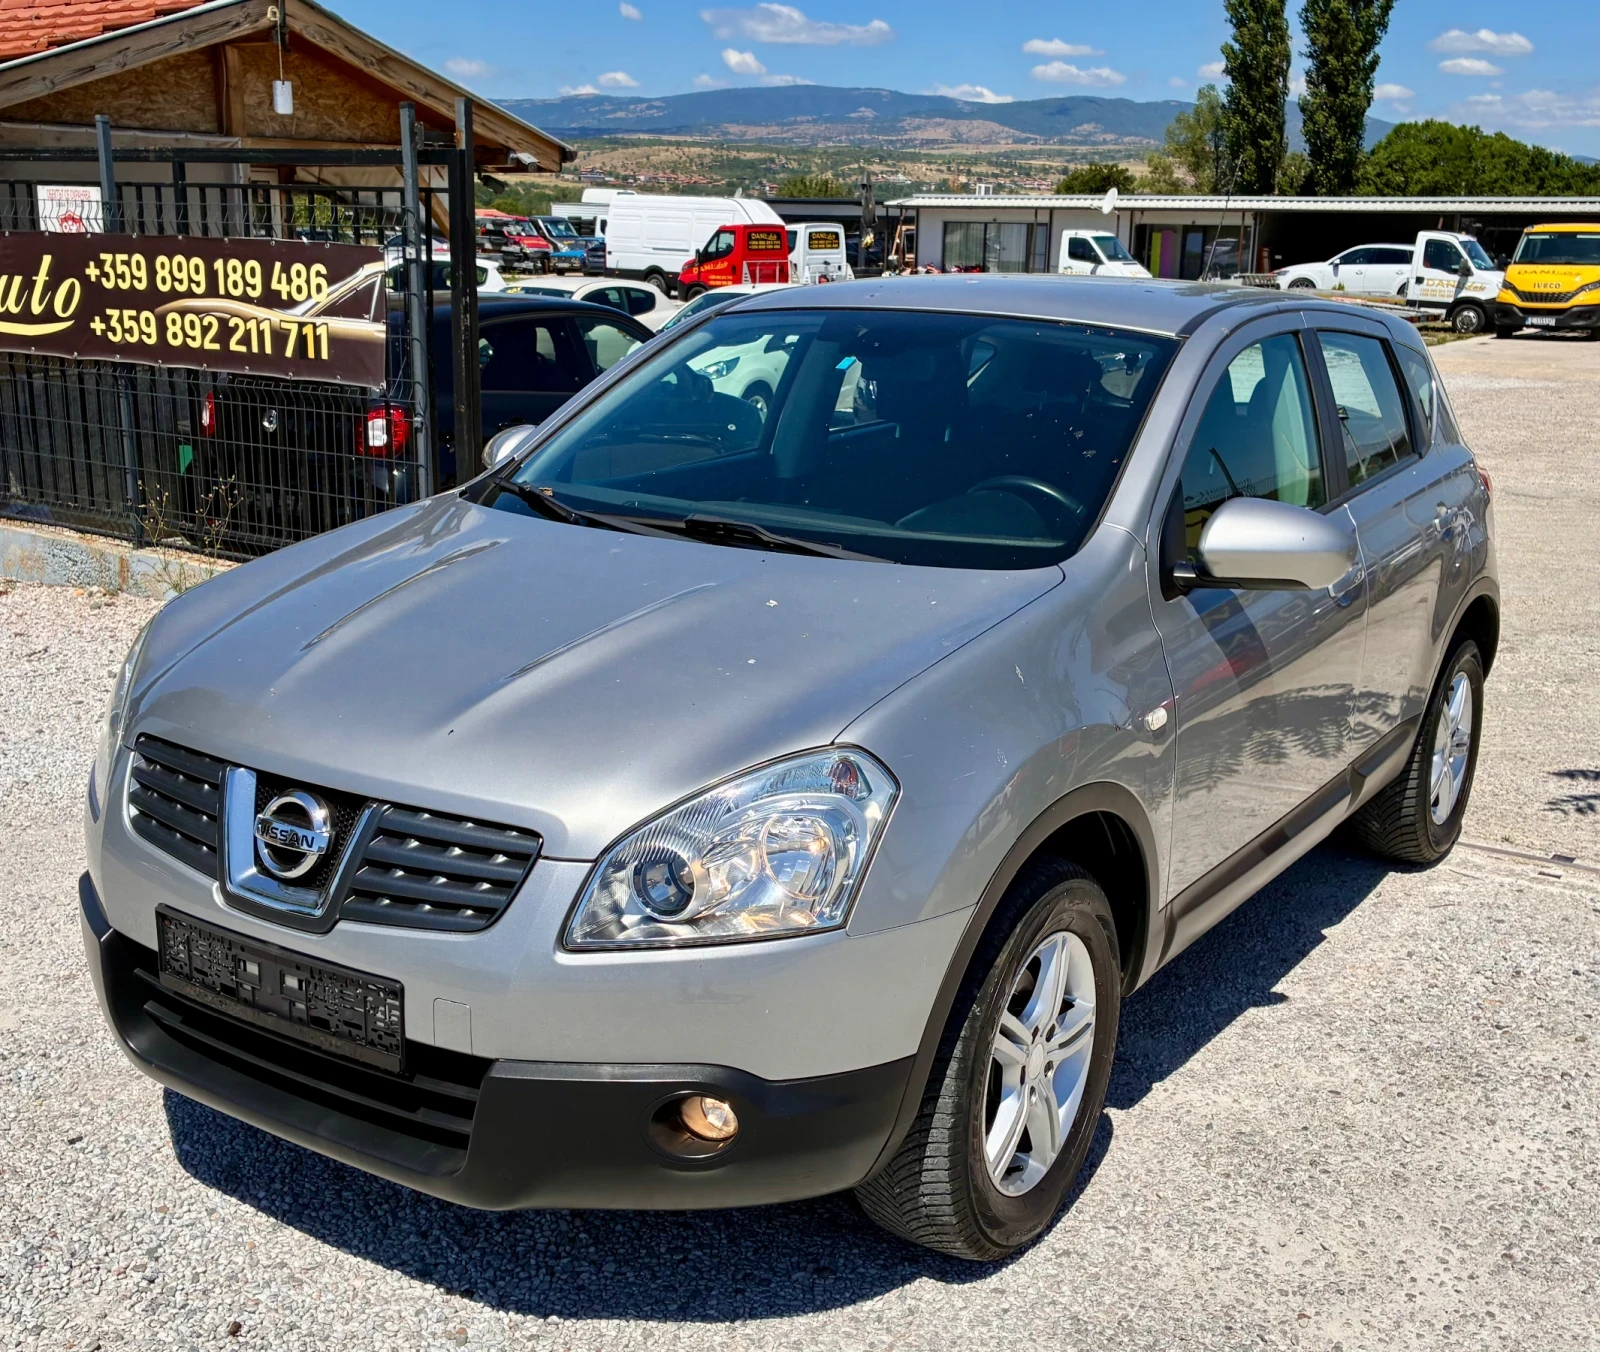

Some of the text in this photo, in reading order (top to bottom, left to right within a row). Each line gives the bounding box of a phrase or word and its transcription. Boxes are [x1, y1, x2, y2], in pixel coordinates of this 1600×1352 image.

[85, 253, 328, 302] +359 899 189 486
[90, 308, 329, 360] +359 892 211 711
[258, 820, 315, 848] NISSAN
